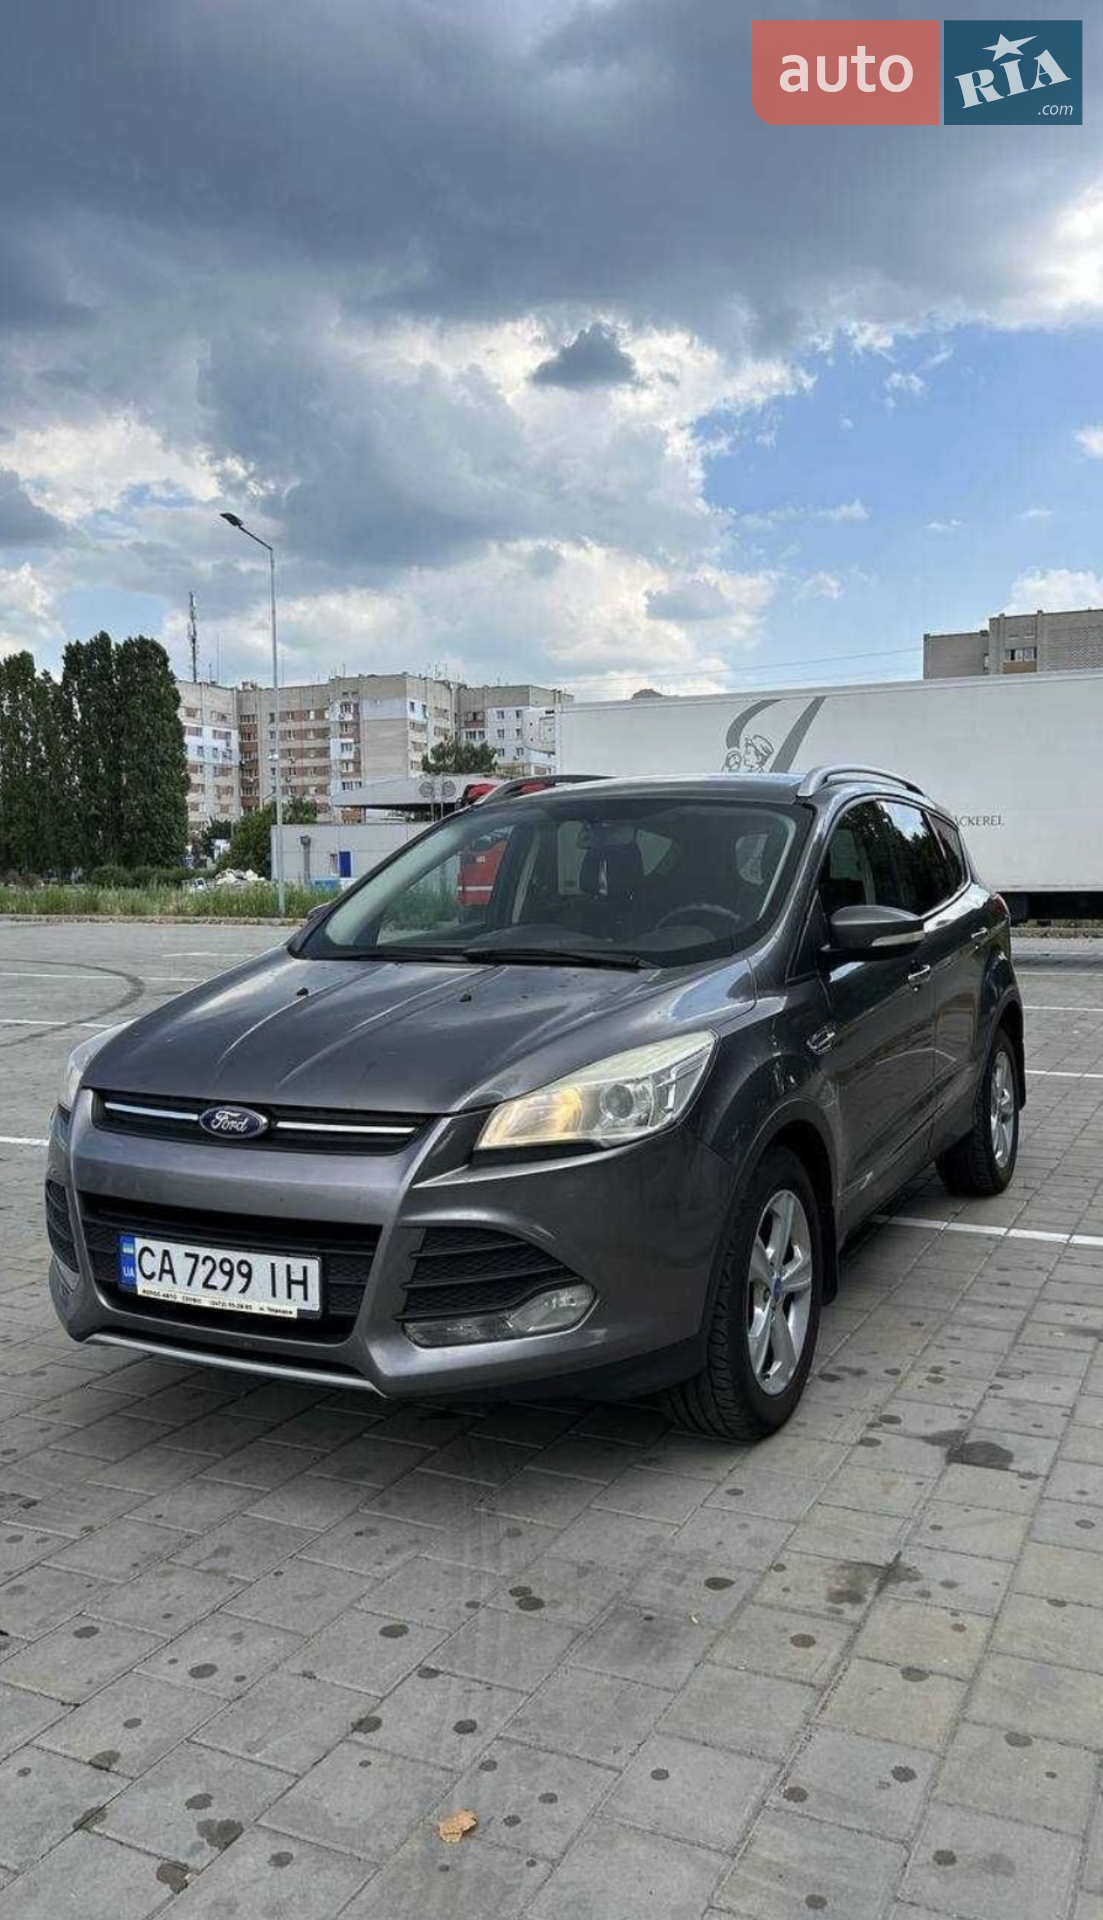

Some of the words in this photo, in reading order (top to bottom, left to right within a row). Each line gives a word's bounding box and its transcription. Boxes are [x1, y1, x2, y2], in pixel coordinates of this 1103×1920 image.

[211, 1110, 249, 1132] Ford
[123, 1266, 135, 1278] UA
[138, 1246, 177, 1284] CA
[184, 1252, 253, 1294] 7299
[270, 1262, 308, 1301] IH
